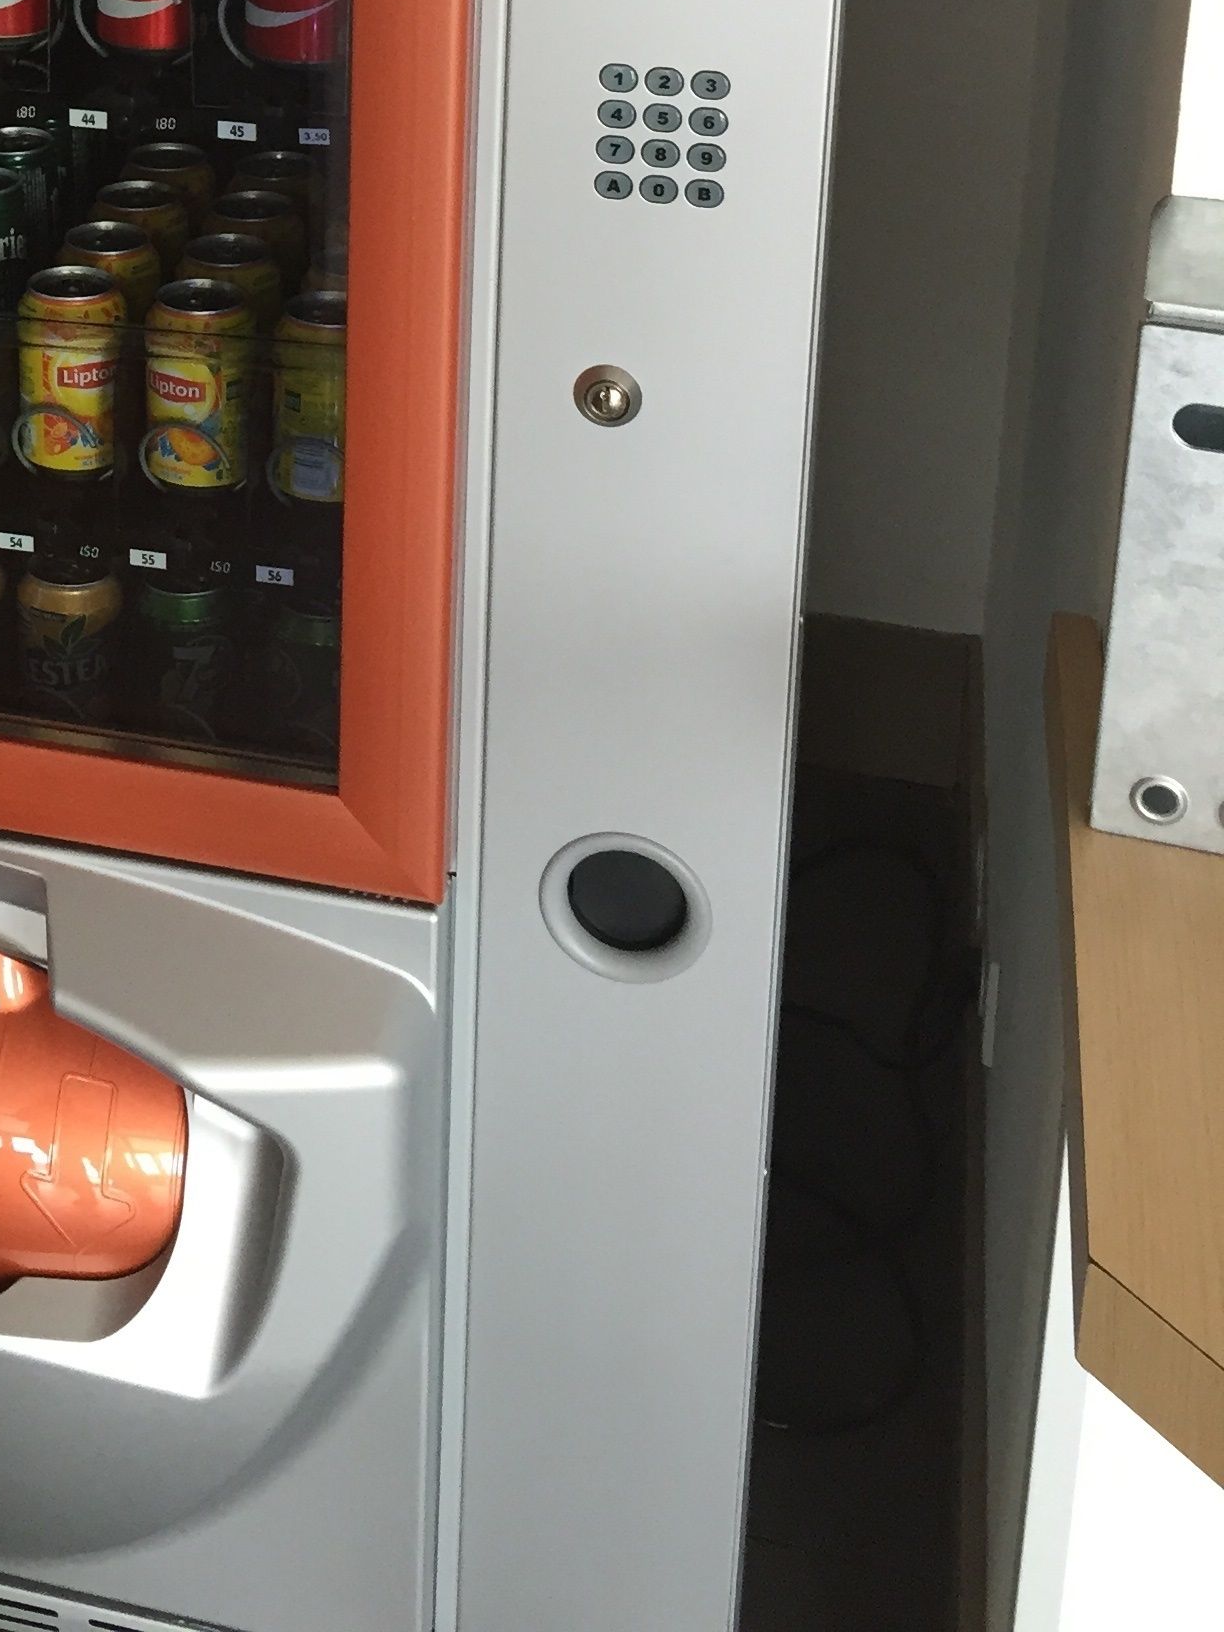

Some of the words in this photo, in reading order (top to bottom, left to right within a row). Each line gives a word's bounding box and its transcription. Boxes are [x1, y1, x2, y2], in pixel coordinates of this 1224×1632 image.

[614, 72, 623, 85] 1
[659, 75, 670, 89] 2
[706, 79, 716, 92] 3
[81, 113, 95, 125] 44
[611, 109, 623, 121] 4
[657, 112, 668, 124] 5
[704, 116, 714, 129] 6
[230, 125, 244, 137] 45
[610, 143, 621, 156] 7
[656, 148, 666, 161] 8
[701, 152, 712, 165] 9
[607, 178, 620, 193] A
[653, 184, 664, 196] 0
[698, 188, 711, 201] B
[63, 368, 111, 387] Lipto
[10, 537, 22, 548] 54
[141, 554, 155, 565] 55
[268, 570, 282, 582] 56
